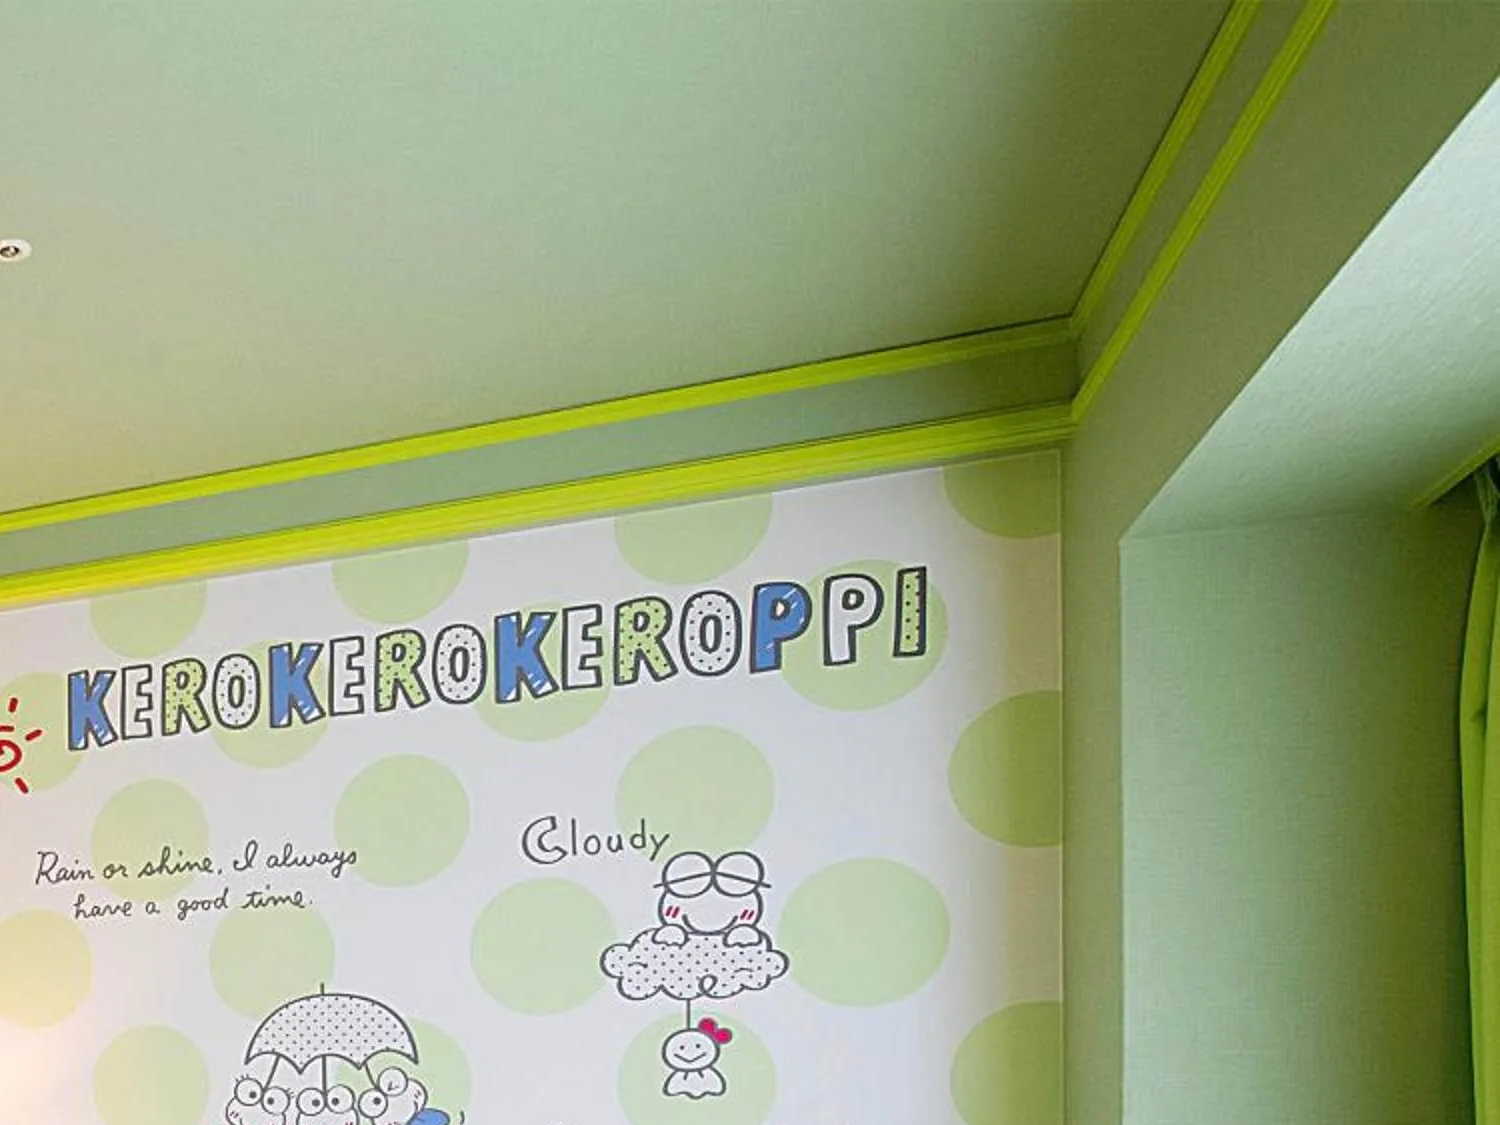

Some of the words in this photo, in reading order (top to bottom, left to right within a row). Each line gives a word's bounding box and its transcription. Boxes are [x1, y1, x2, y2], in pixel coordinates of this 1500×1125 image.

[65, 566, 928, 752] KEROKEROKEROPPI
[520, 814, 672, 866] Cloudy
[35, 850, 96, 886] Rain
[101, 863, 129, 881] or
[232, 845, 259, 873] I
[265, 846, 358, 880] always
[72, 893, 133, 920] have
[144, 901, 161, 915] a
[177, 887, 229, 922] good
